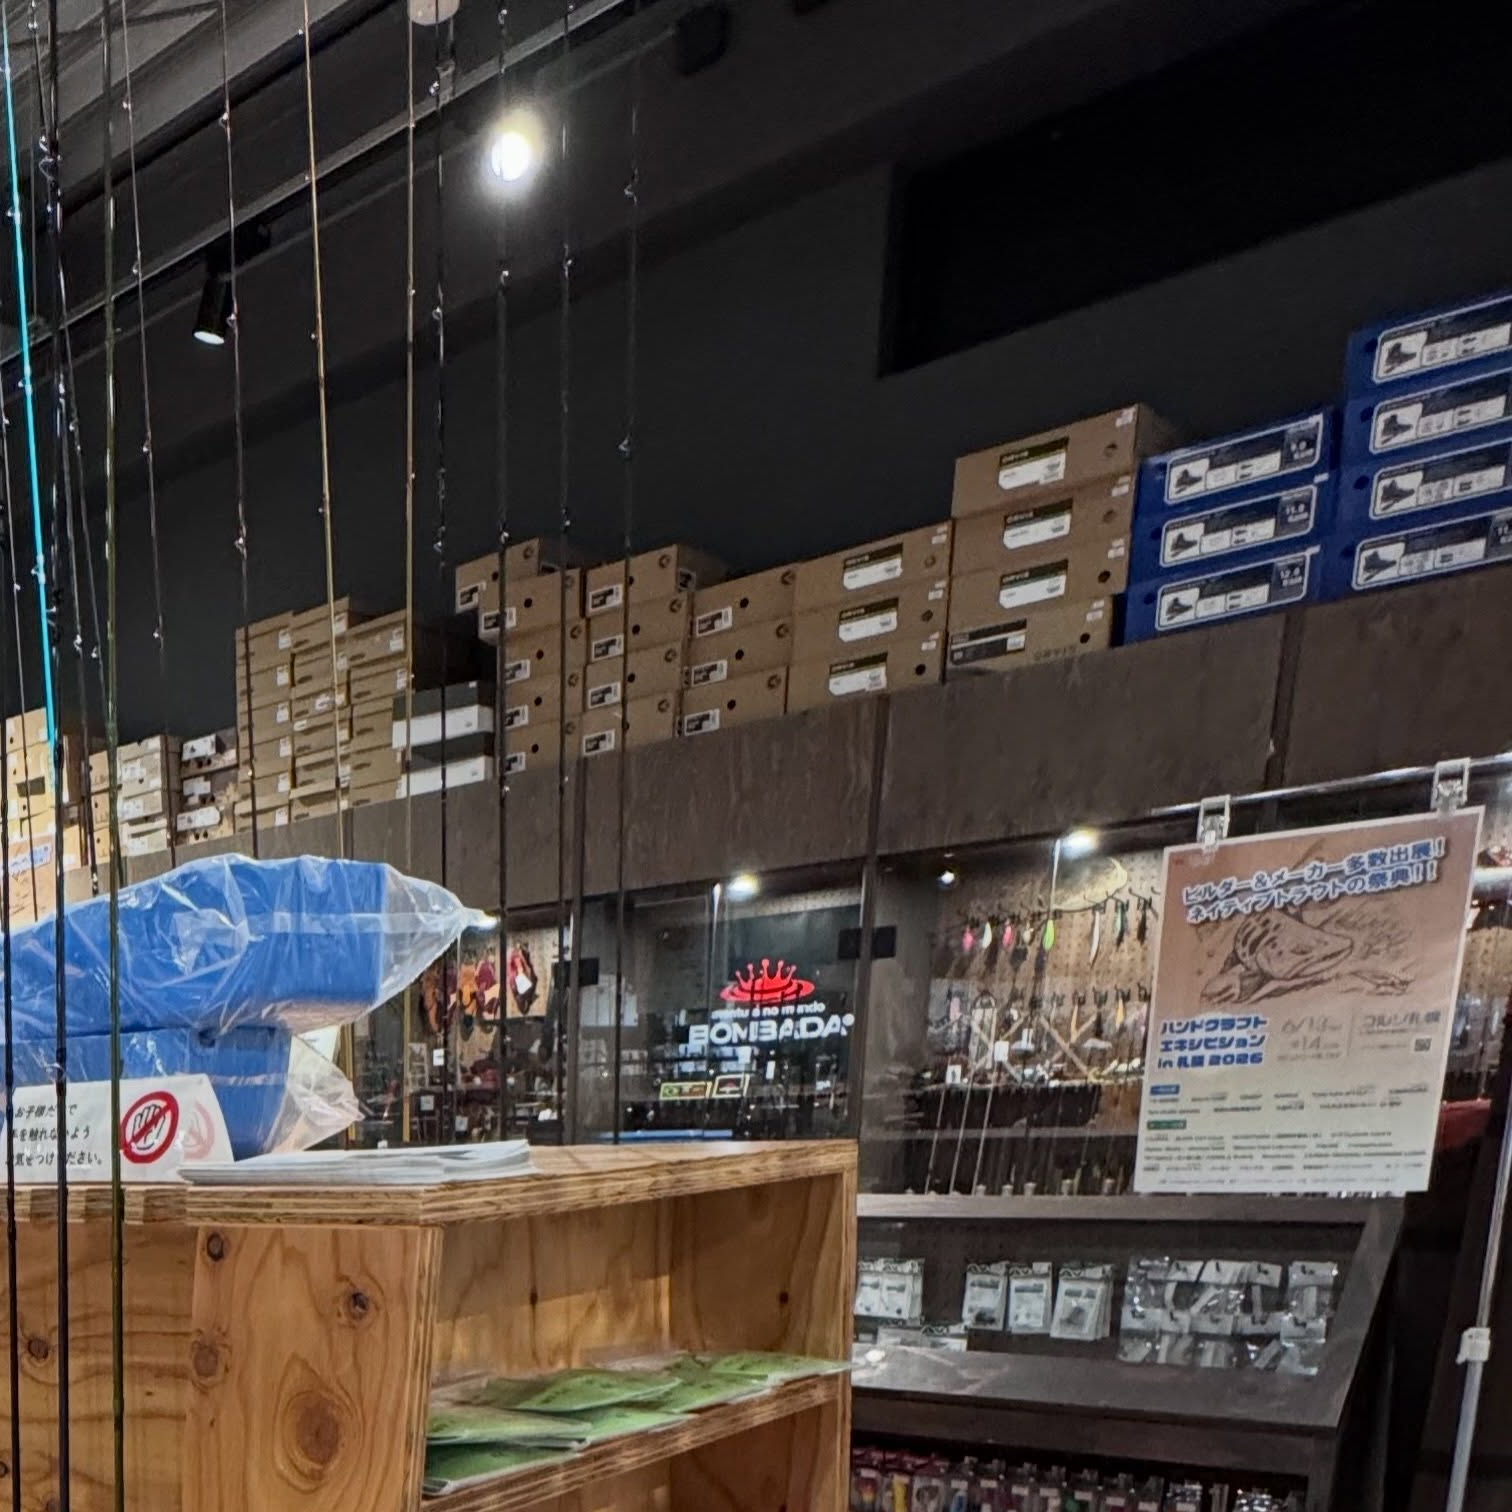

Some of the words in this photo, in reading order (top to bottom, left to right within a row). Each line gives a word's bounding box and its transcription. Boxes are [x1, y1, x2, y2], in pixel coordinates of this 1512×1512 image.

[1160, 1016, 1267, 1035] ハンドクラフト
[1159, 1034, 1267, 1051] エキシビション
[1209, 1052, 1264, 1066] 2026
[15, 1103, 78, 1120] お子様だで
